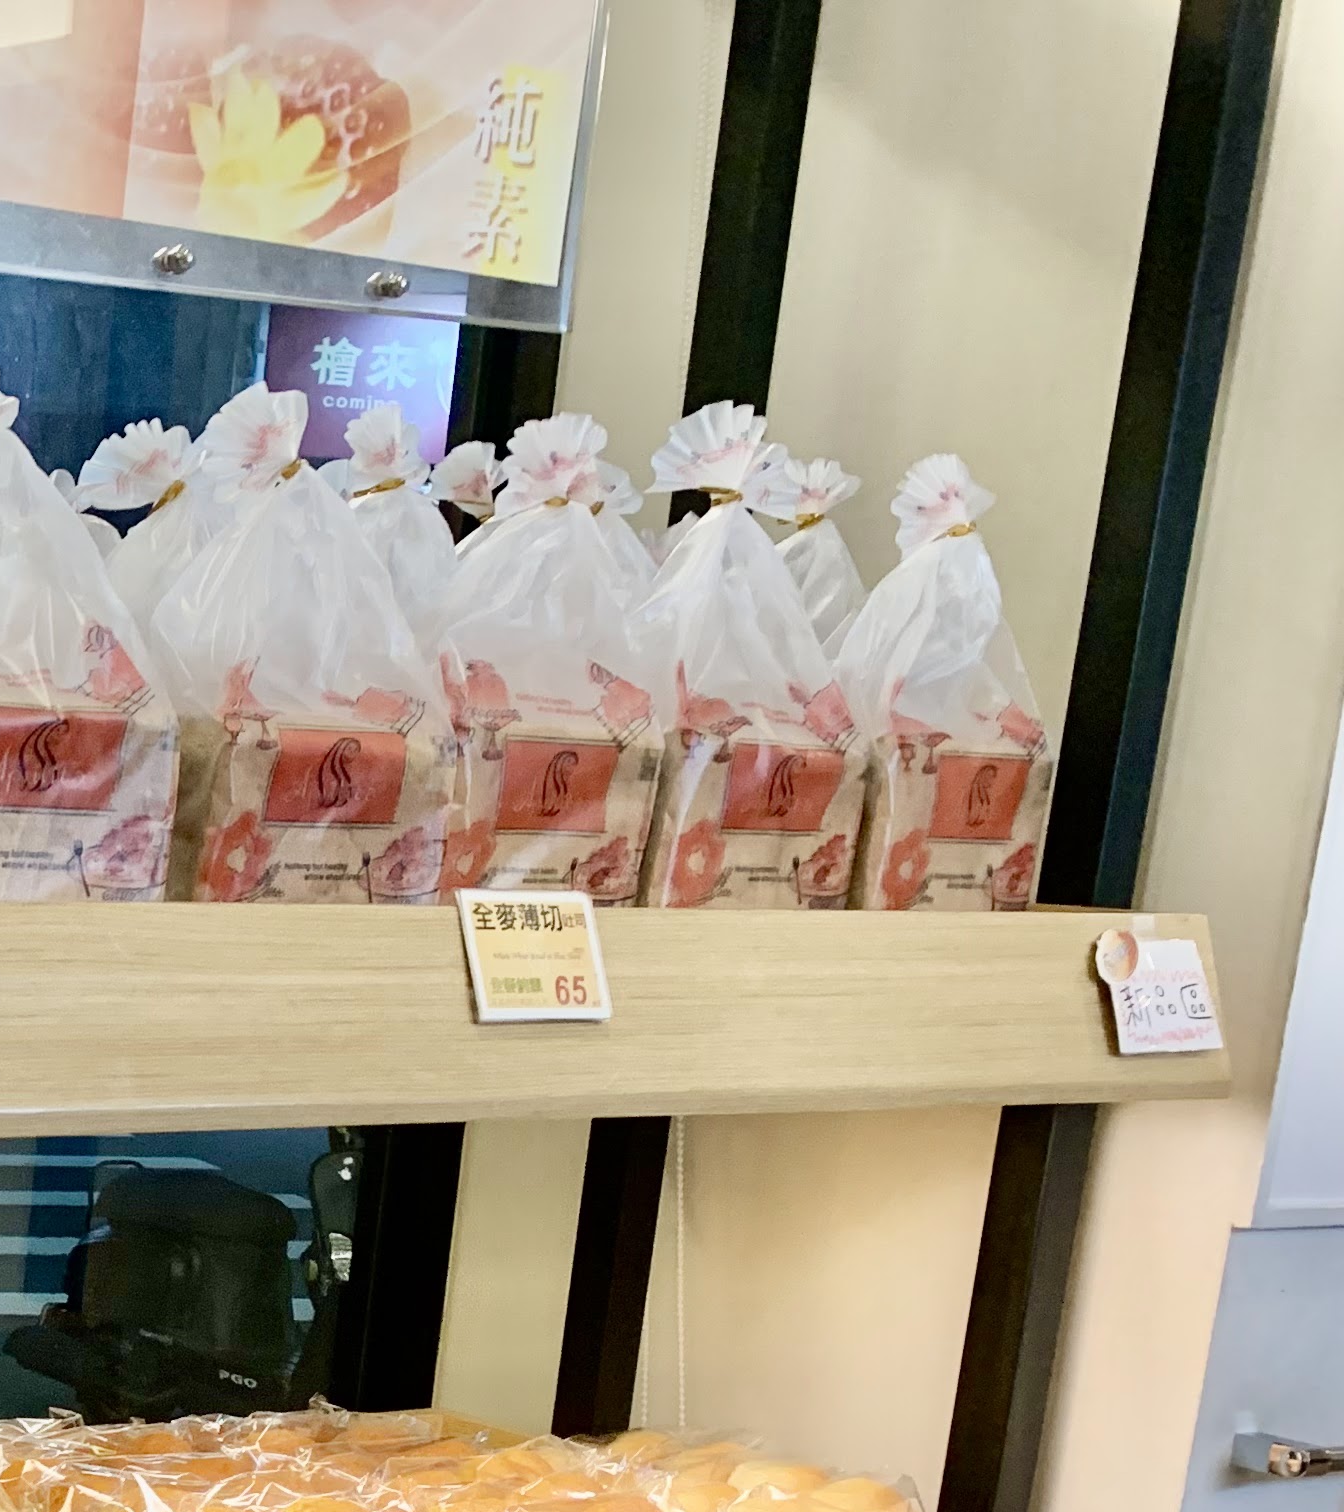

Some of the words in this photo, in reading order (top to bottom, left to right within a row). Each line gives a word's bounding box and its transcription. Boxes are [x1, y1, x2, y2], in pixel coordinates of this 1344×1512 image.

[463, 72, 544, 265] 純素
[555, 975, 587, 1006] 65
[1120, 983, 1212, 1028] 新品區
[218, 1369, 258, 1389] PGO
